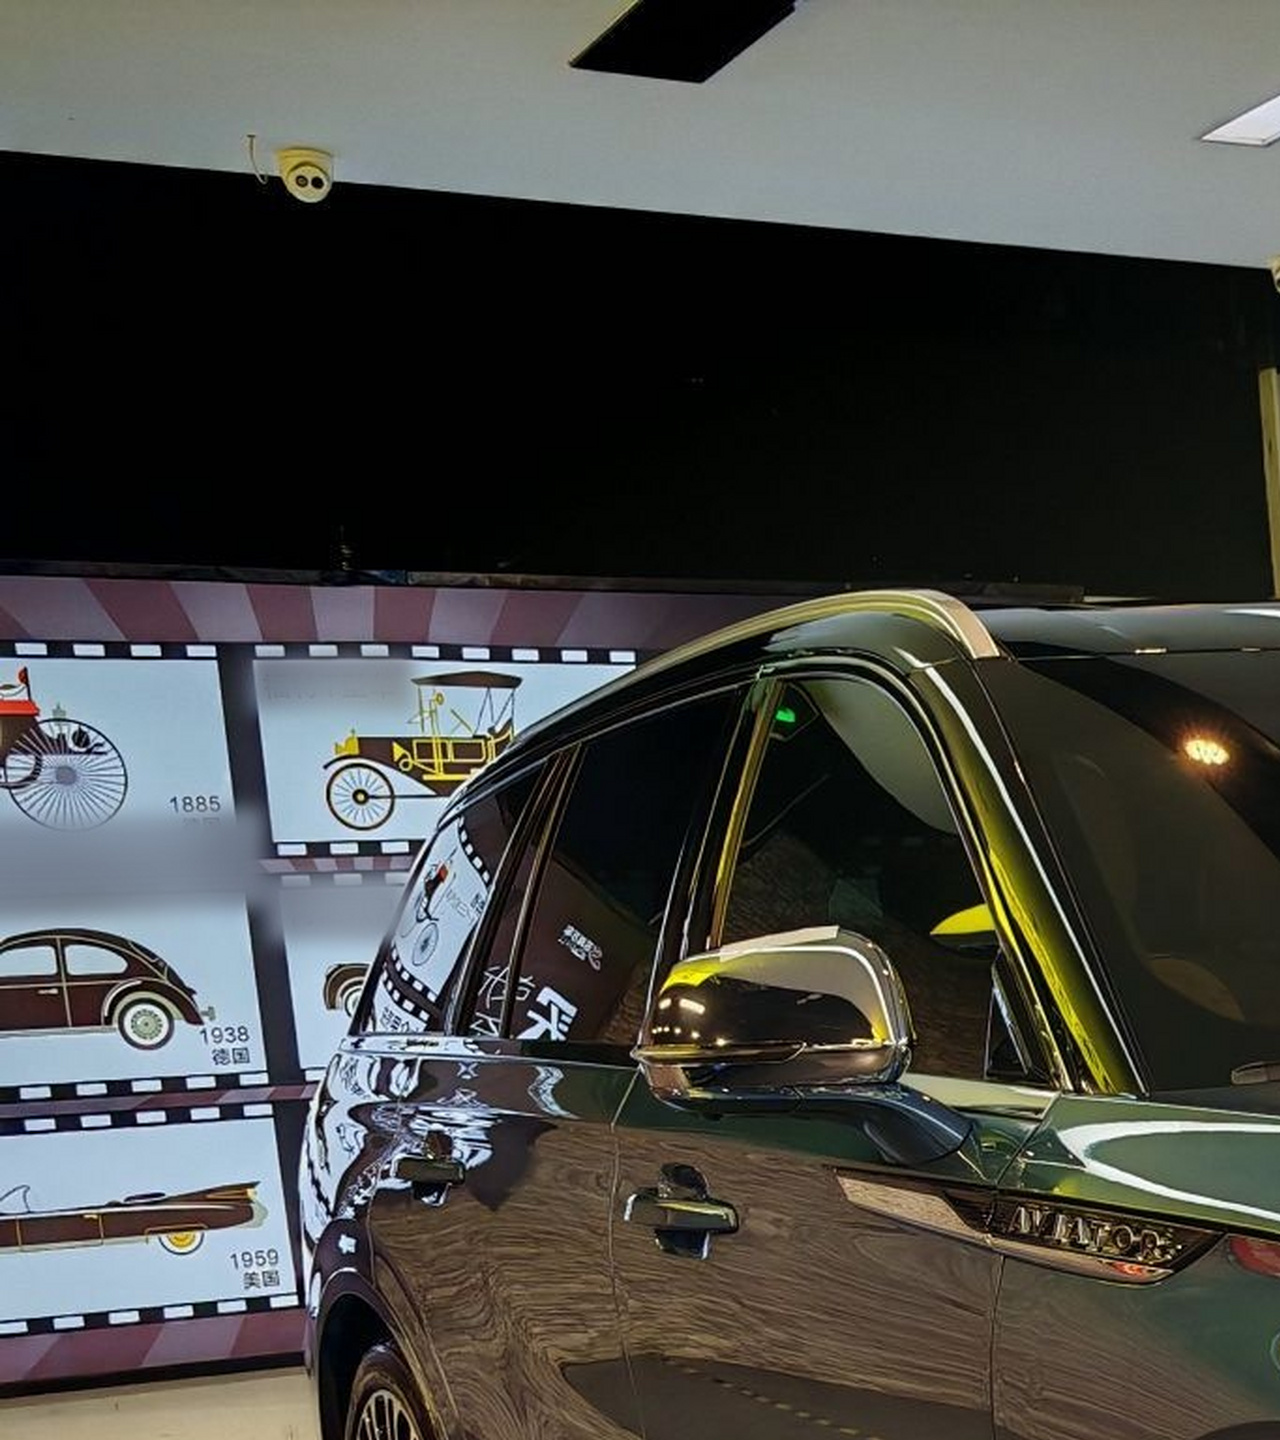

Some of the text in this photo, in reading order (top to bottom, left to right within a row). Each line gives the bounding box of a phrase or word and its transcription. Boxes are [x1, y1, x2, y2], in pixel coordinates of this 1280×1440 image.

[169, 795, 221, 813] 1885
[200, 1025, 250, 1045] 1938
[212, 1047, 250, 1066] 德国
[1007, 1206, 1164, 1263] AVIATOR
[230, 1248, 279, 1270] 1959
[243, 1270, 280, 1290] 美国
